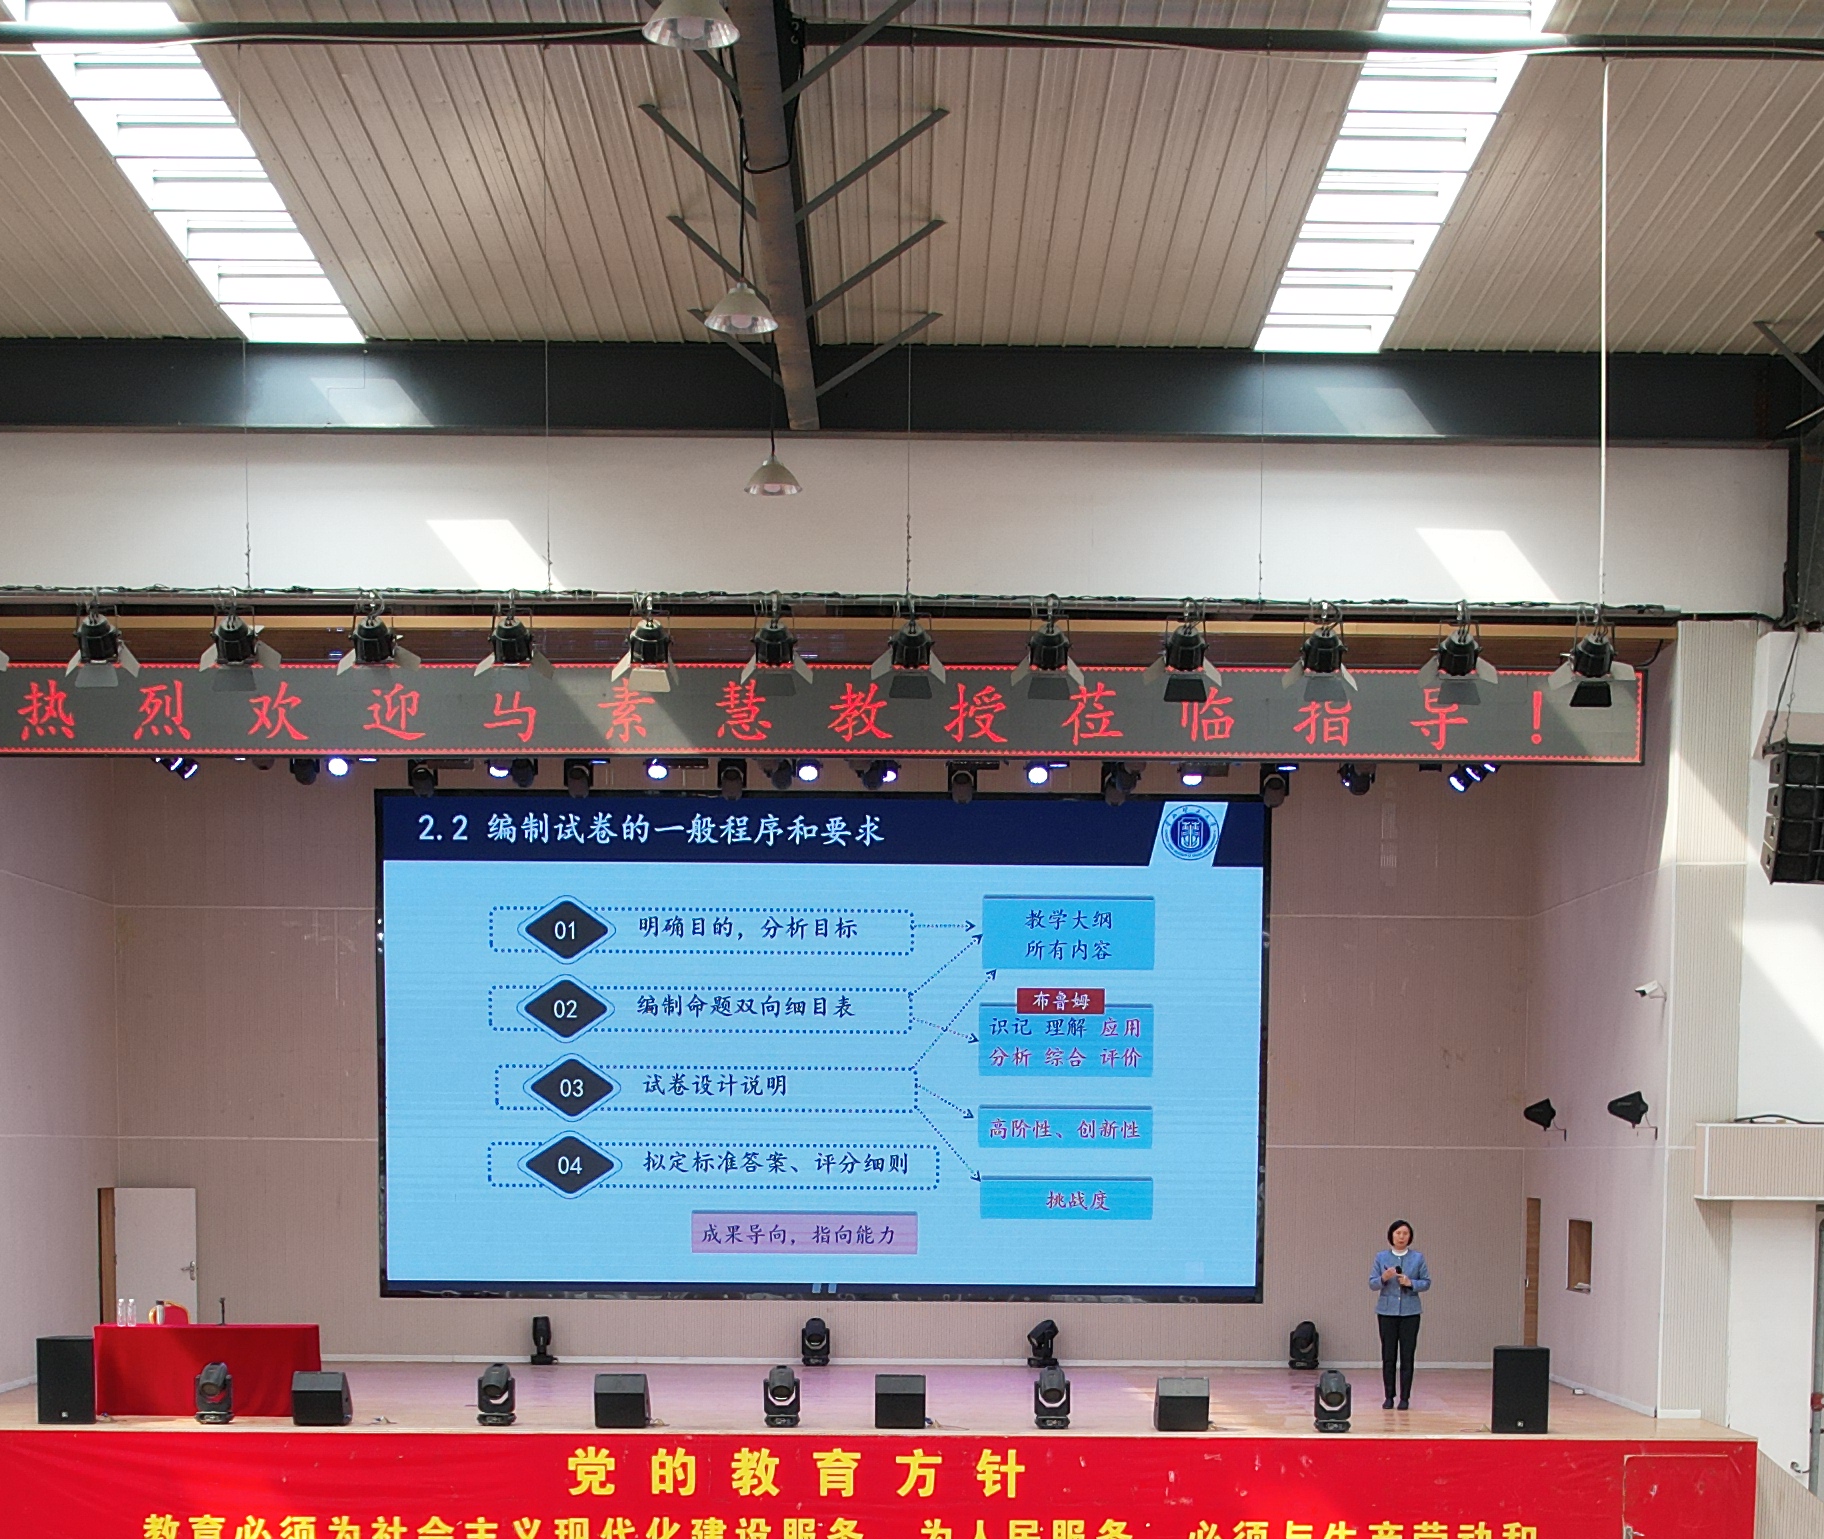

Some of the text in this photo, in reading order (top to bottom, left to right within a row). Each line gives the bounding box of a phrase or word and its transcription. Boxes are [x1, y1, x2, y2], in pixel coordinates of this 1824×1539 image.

[418, 811, 886, 848] 2.2 编制试卷的一般程序和要求
[553, 921, 576, 940] 01
[638, 915, 859, 942] 明确目的，分析目标
[1024, 909, 1113, 930] 教学大纲
[1024, 939, 1113, 961] 所有内容
[553, 1000, 578, 1019] 02
[637, 994, 856, 1019] 编制命题双向细目表
[1032, 990, 1091, 1011] 布鲁姆
[989, 1017, 1141, 1038] 识记 理解 应用
[989, 1046, 1143, 1069] 分析 综合 评价
[559, 1079, 584, 1098] 03
[642, 1073, 788, 1098] 试卷设计说明
[989, 1118, 1141, 1140] 高阶性、创新性
[557, 1155, 583, 1175] 04
[642, 1150, 910, 1176] 拟定标准答案、评分细则
[1046, 1189, 1111, 1212] 挑战度
[701, 1223, 896, 1247] 成果导向，指向能力
[567, 1447, 1025, 1499] 党的教育方针
